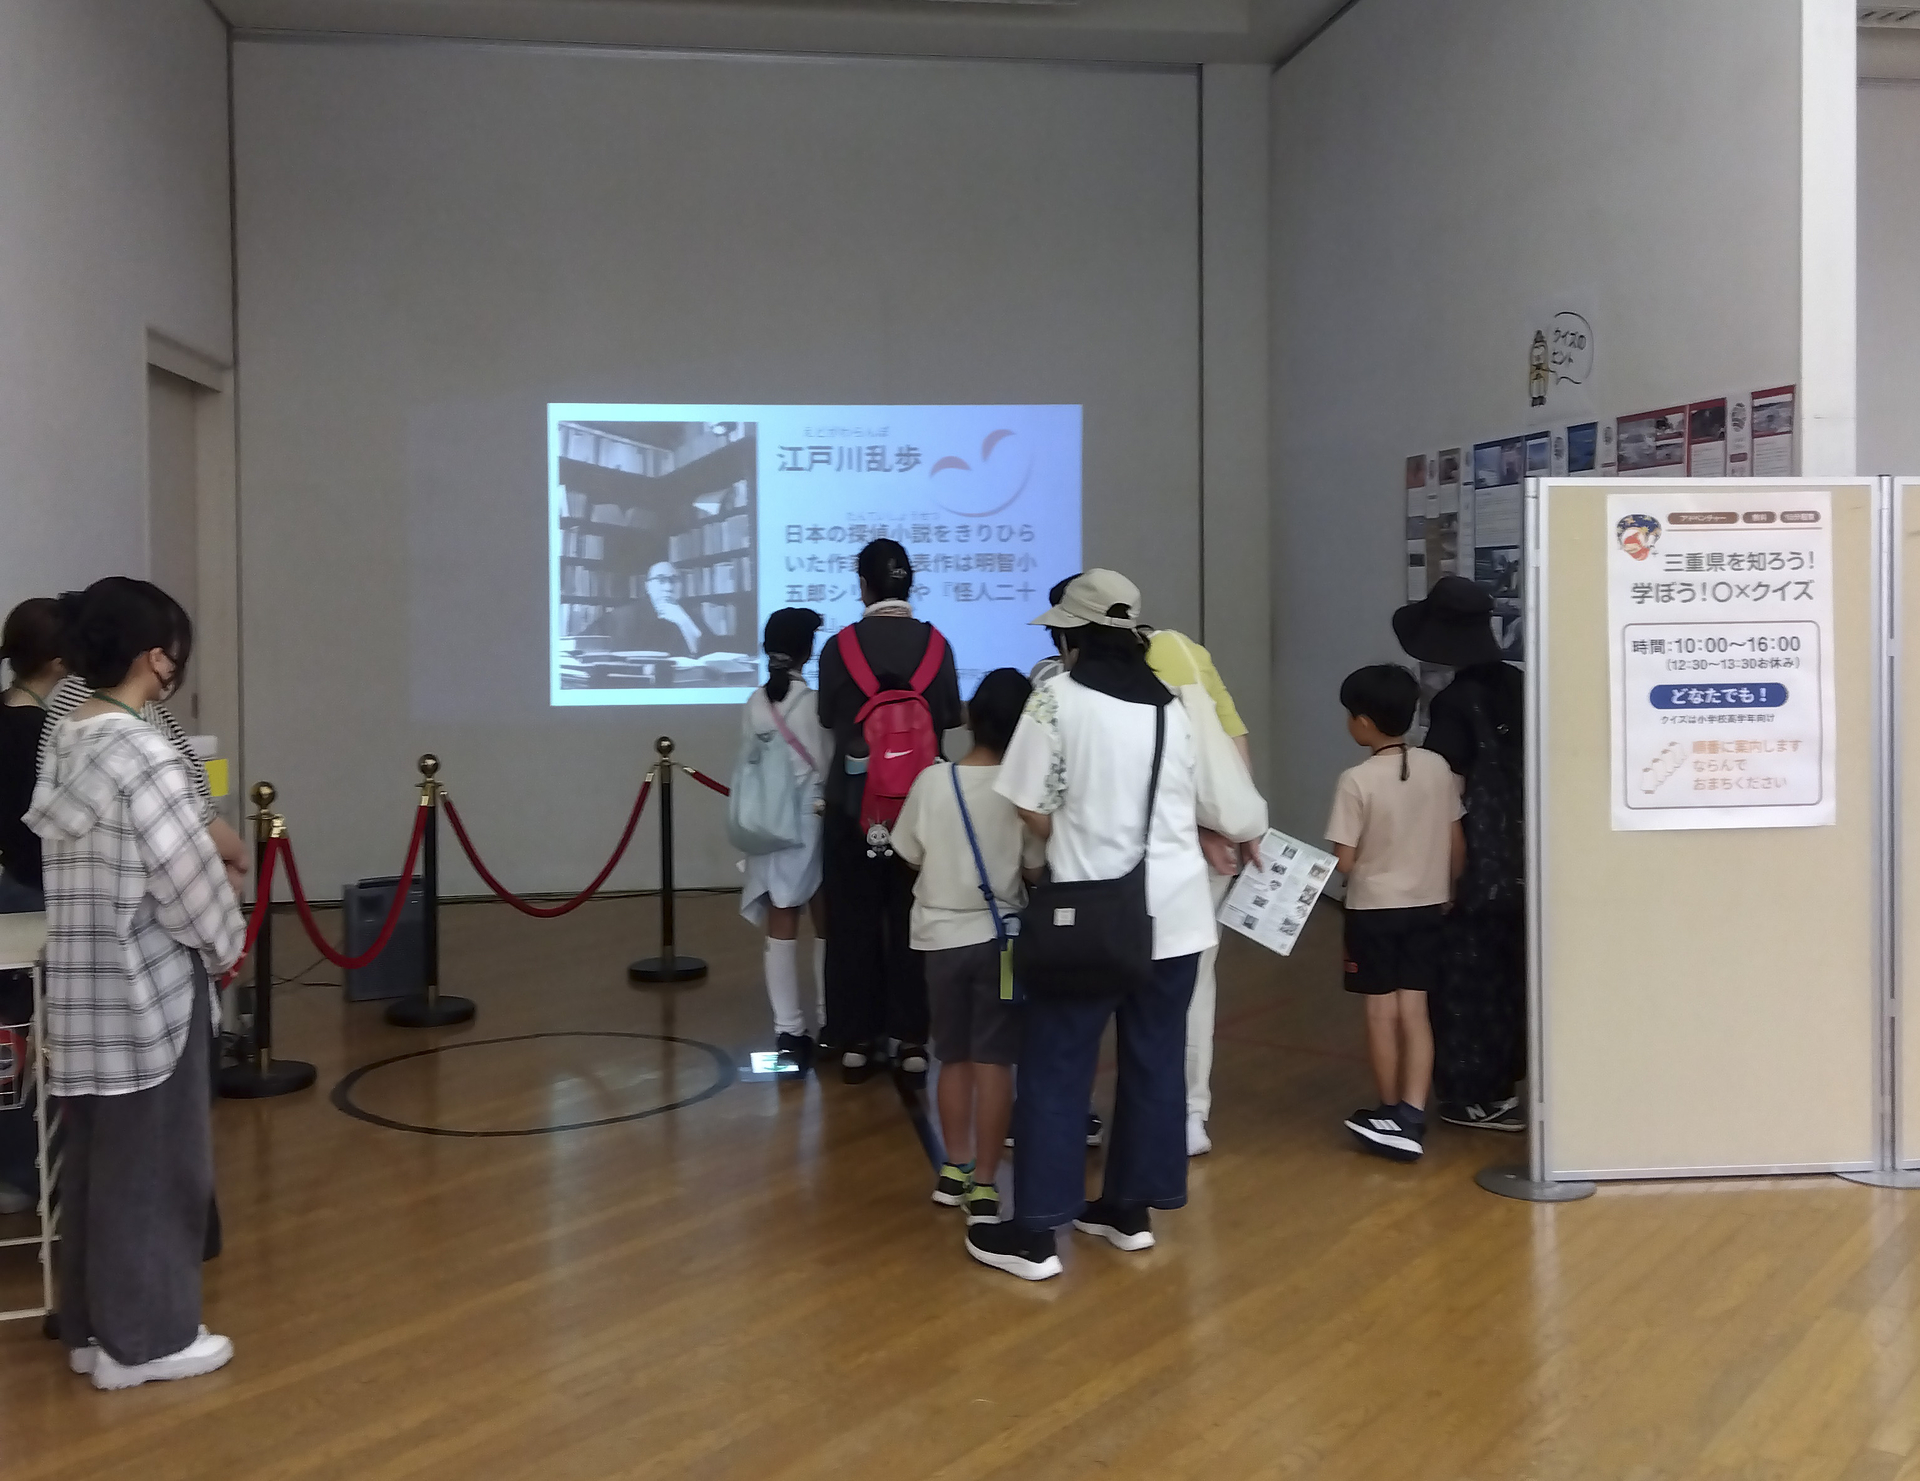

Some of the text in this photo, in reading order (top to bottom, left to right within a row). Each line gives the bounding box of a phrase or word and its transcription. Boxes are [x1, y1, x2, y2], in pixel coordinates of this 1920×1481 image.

[776, 444, 923, 472] 江戸川乱歩
[785, 523, 1036, 544] 日本の探偵小説をきりひら
[1663, 550, 1815, 573] 三重県を知ろう！
[1671, 687, 1768, 705] どなたでも！
[1661, 714, 1775, 724] クイズは小学校高学年向け
[1693, 777, 1787, 790] おまちください
